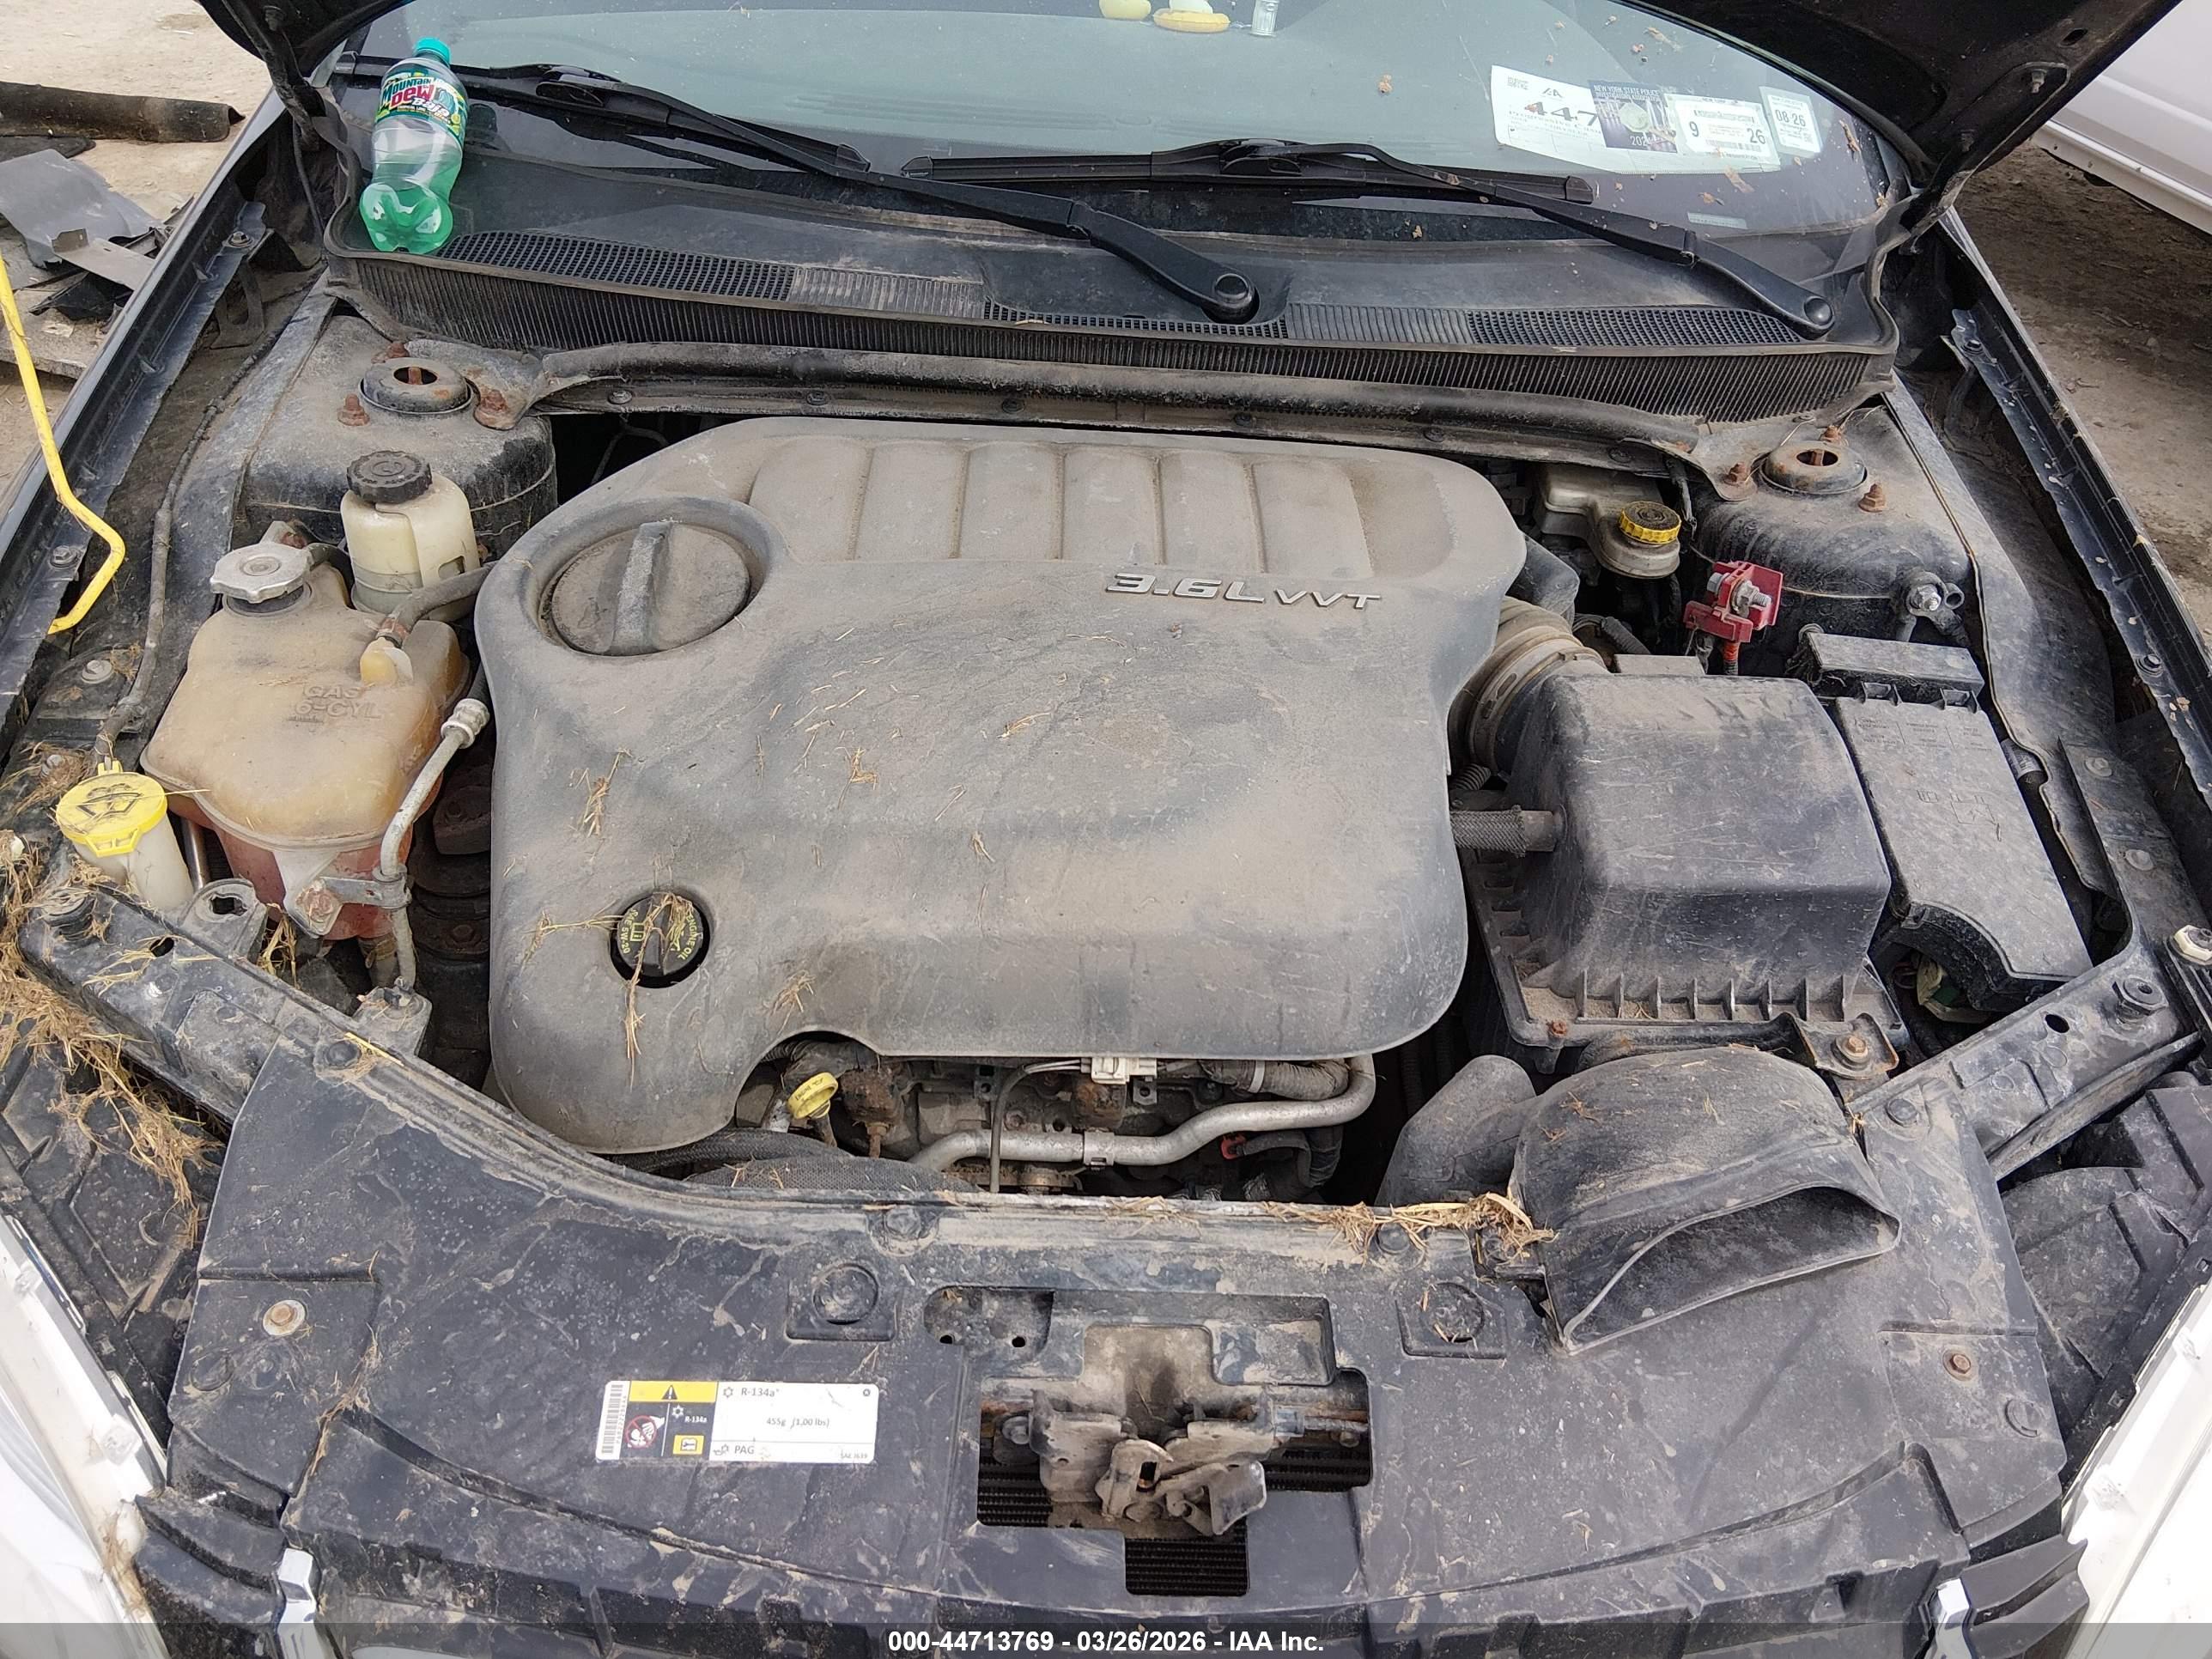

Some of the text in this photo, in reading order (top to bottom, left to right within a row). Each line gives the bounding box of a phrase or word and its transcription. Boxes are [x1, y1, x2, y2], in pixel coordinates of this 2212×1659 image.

[1607, 85, 1622, 94] YORK
[1622, 87, 1640, 95] STATE
[1640, 88, 1659, 97] POLICE
[1689, 121, 1699, 137] 9
[1747, 128, 1766, 145] 26
[1105, 572, 1382, 610] 3.6L VVT
[303, 684, 362, 699] GAS
[295, 699, 383, 720] 6-CYL
[621, 908, 639, 954] SAE 5W-20
[677, 946, 692, 960] OIL
[766, 1417, 787, 1427] 455g
[734, 1445, 756, 1455] PAG
